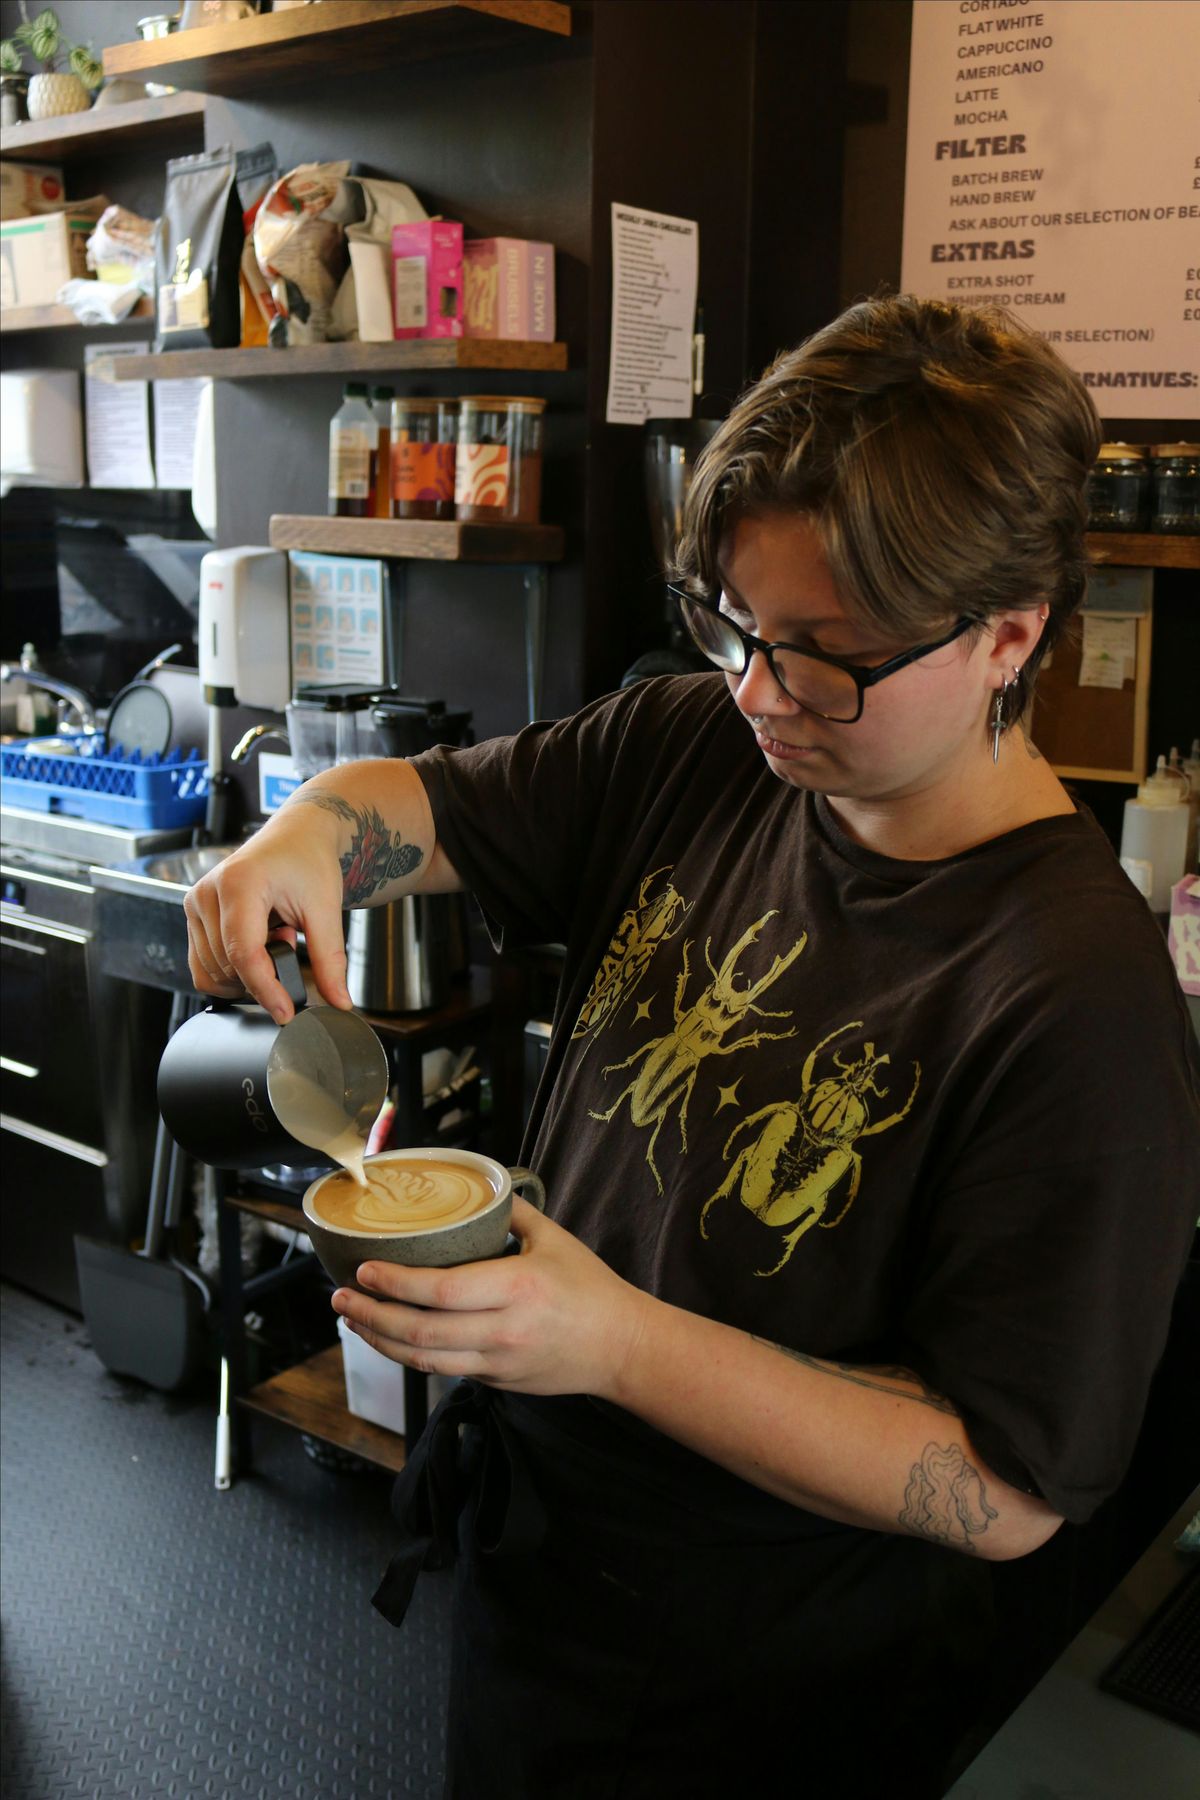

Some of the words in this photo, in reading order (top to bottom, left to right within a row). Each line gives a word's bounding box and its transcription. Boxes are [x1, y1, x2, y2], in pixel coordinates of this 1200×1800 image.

[958, 21, 994, 36] FLAT
[996, 14, 1044, 32] WHITE
[957, 36, 1053, 58] CAPPUCCINO
[956, 60, 1044, 81] AMERICANO
[955, 88, 999, 104] LATTE
[954, 110, 1008, 126] MOCHA
[935, 134, 1027, 160] FILTER
[951, 172, 998, 187] BATCH
[1001, 168, 1044, 183] BREW
[949, 192, 990, 207] HAND
[993, 189, 1036, 203] BREW
[949, 219, 976, 231] ASK
[980, 216, 1028, 229] ABOUT
[1031, 213, 1061, 227] OUR
[1065, 208, 1150, 225] SELECTION
[1153, 206, 1175, 220] OF
[931, 239, 1035, 263] EXTRAS
[533, 255, 546, 275] IN
[947, 276, 992, 289] EXTRA
[995, 274, 1034, 287] SHOT
[533, 280, 546, 333] MADE
[946, 294, 1011, 306] WHIPPED
[1014, 292, 1065, 305] CREAM
[1065, 329, 1154, 342] SELECTION)
[242, 1077, 268, 1133] edo
